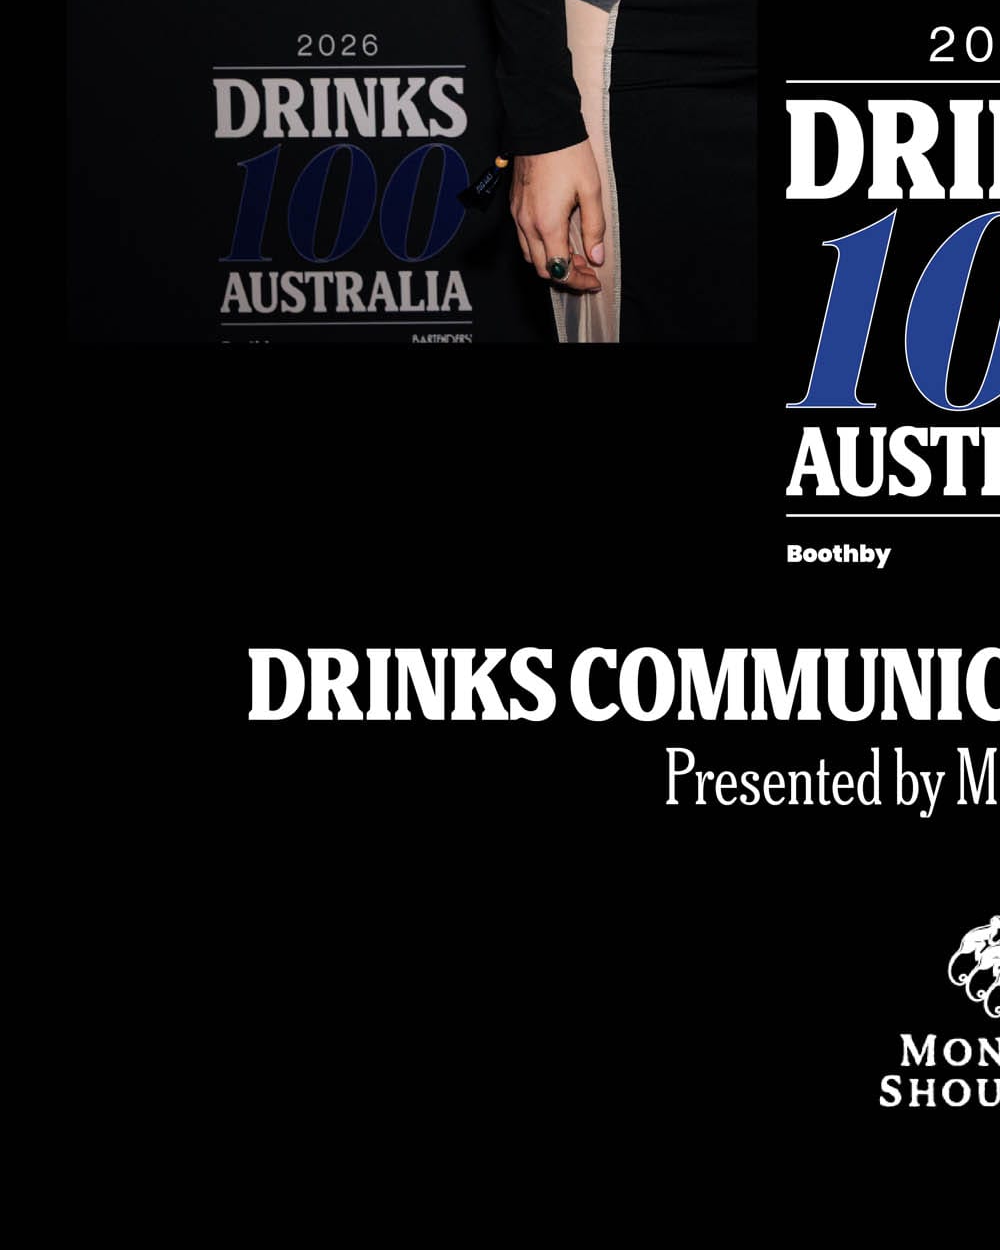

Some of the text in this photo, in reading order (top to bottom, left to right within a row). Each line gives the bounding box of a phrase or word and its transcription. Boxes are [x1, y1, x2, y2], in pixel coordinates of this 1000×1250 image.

[298, 34, 377, 56] 2026
[213, 76, 467, 138] DRINKS
[218, 143, 469, 263] 100
[221, 271, 472, 313] AUSTRALIA
